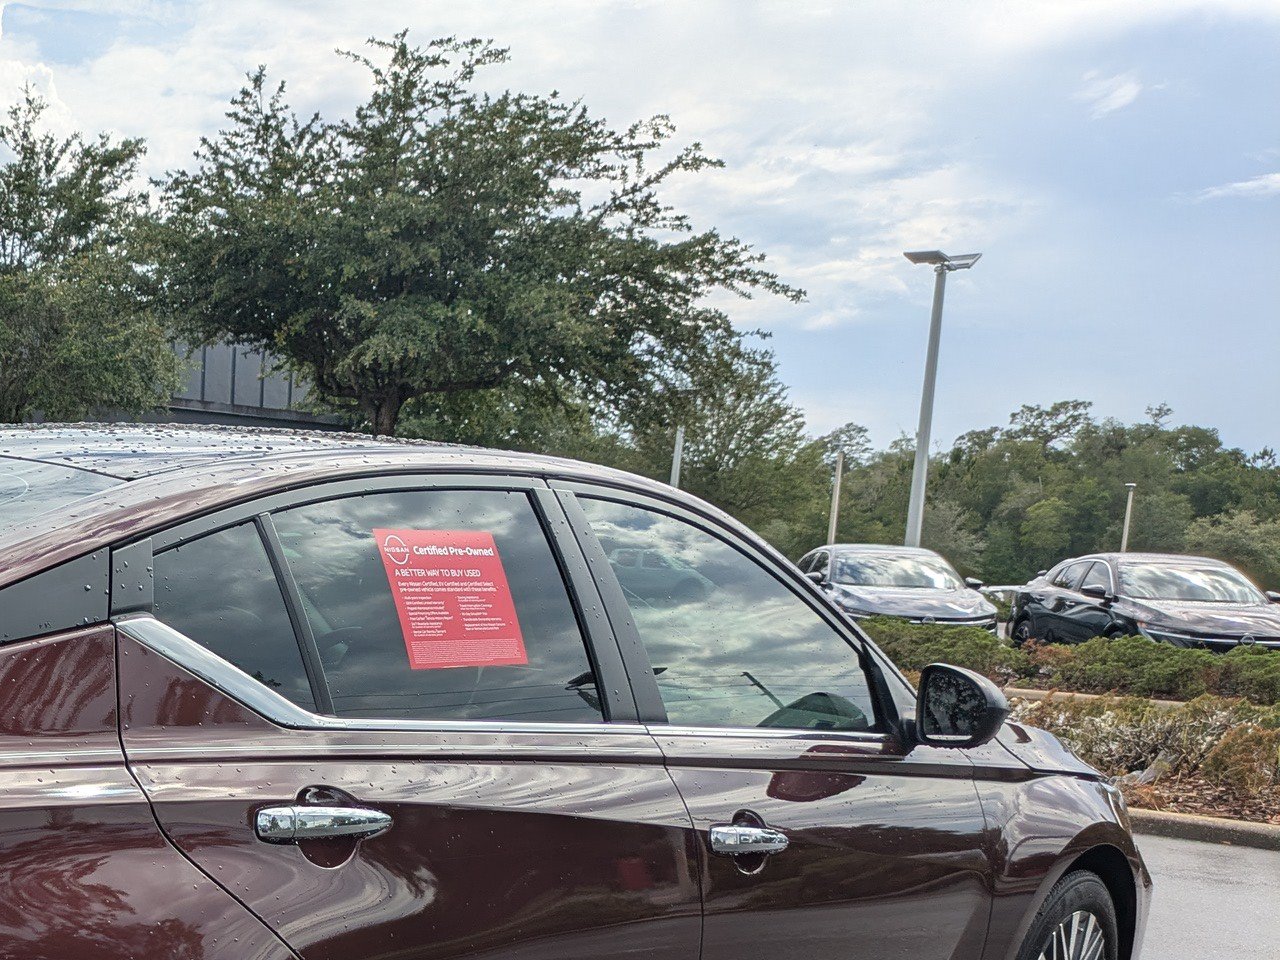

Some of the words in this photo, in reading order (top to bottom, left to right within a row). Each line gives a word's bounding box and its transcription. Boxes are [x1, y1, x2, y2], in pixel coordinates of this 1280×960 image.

[413, 545, 448, 555] Certified
[449, 546, 494, 556] Pre-Owned
[426, 569, 439, 577] WAY
[440, 569, 451, 577] TO
[451, 569, 463, 577] BUY
[464, 569, 480, 577] USED
